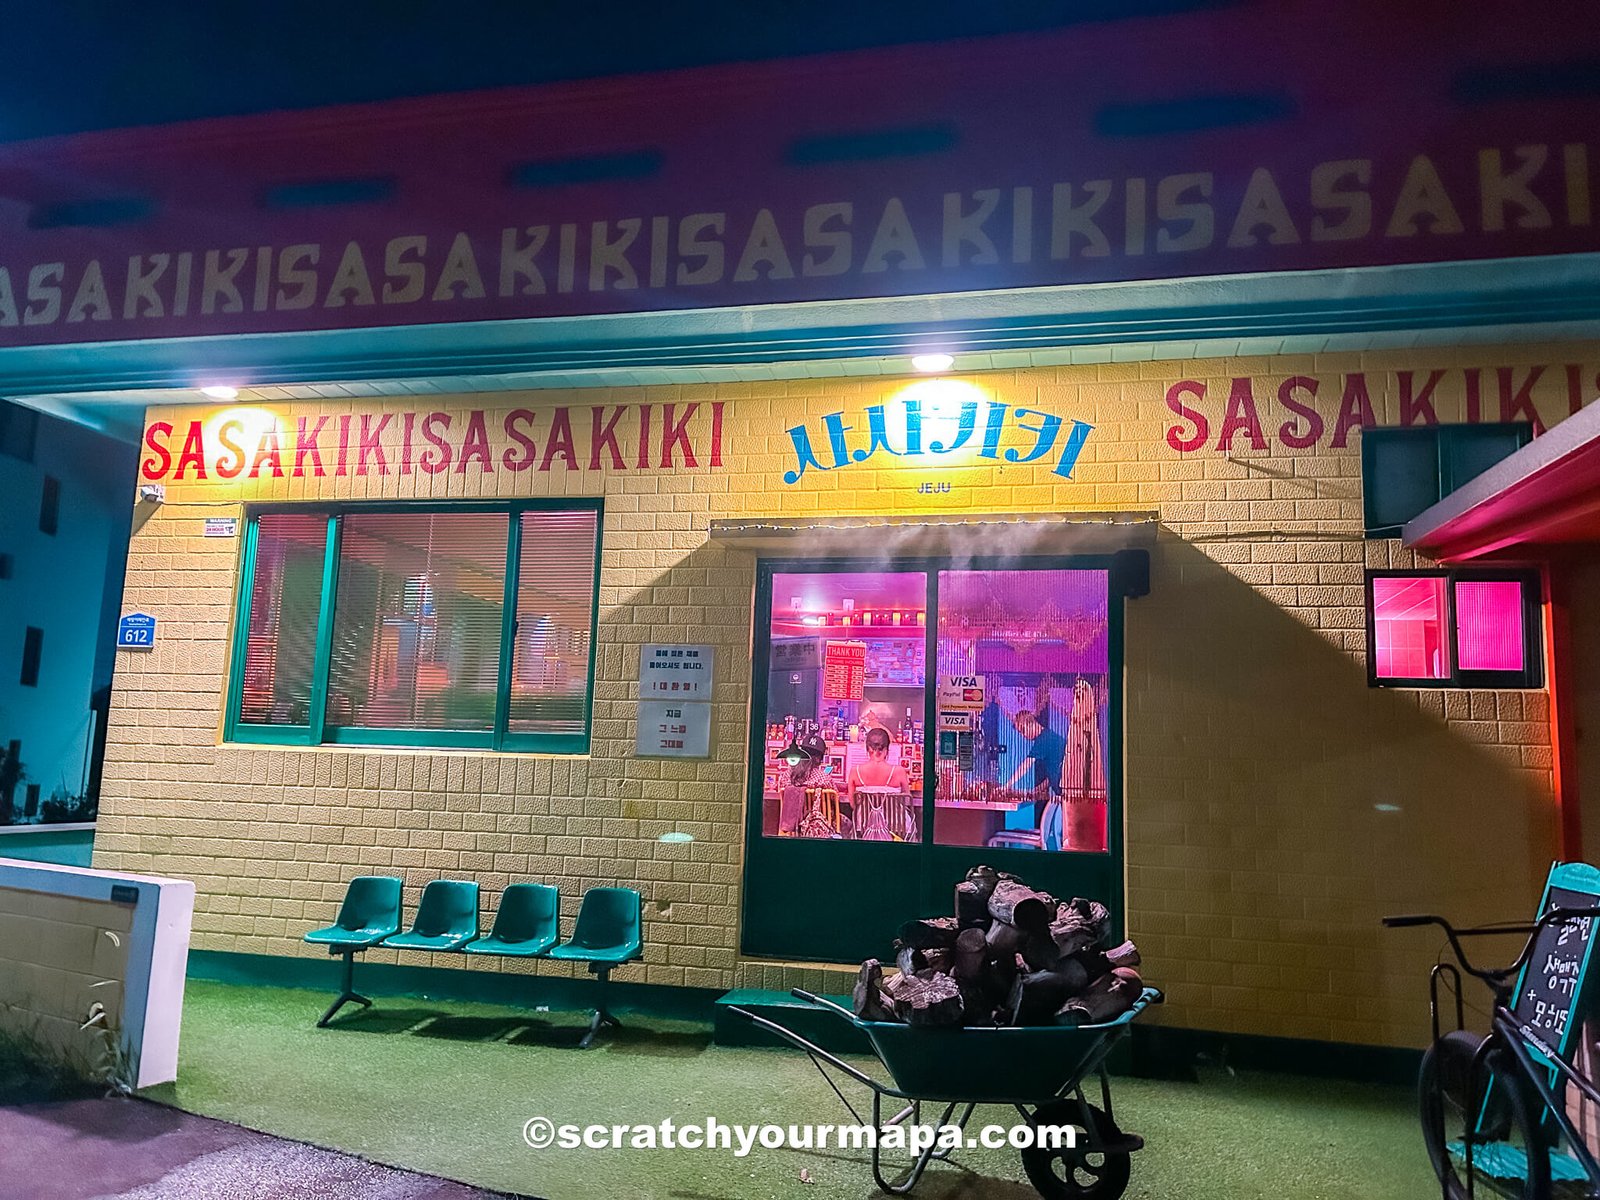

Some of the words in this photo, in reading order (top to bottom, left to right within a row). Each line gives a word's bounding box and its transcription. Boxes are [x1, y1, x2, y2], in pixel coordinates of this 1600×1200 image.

[917, 482, 952, 495] JEJU
[125, 629, 148, 643] 612
[828, 646, 850, 656] THANK
[851, 647, 865, 657] YOU
[951, 677, 977, 687] VISA
[666, 709, 681, 718] 지금
[945, 717, 966, 725] VISA
[659, 725, 667, 733] 그
[1519, 1025, 1556, 1059] Sunday
